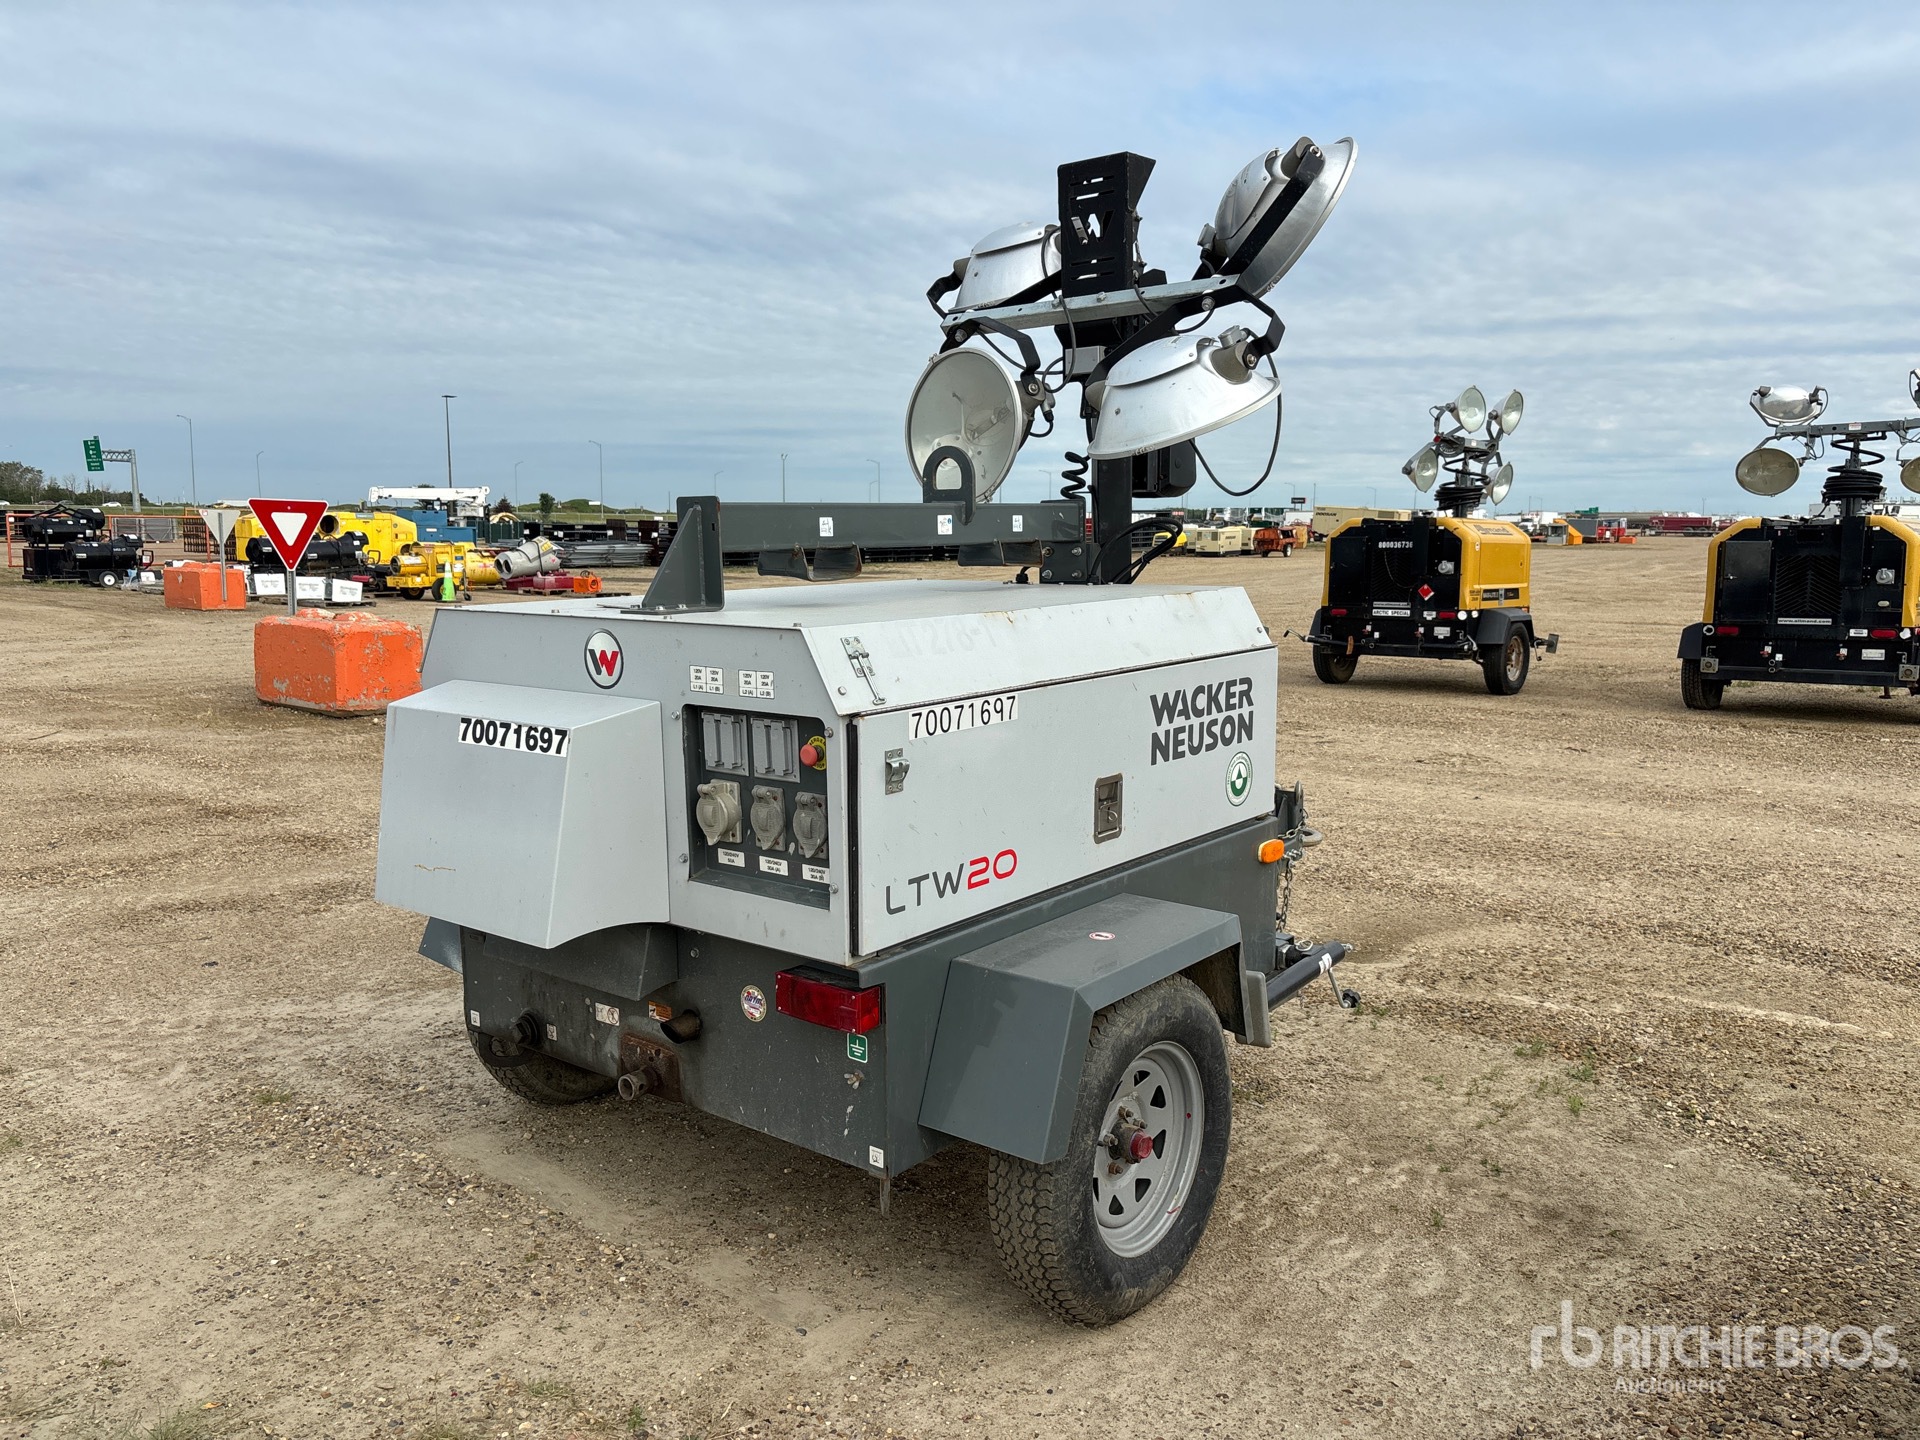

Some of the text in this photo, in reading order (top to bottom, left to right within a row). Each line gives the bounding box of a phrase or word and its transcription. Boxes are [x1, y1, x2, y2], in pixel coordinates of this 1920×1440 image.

[911, 695, 1016, 739] 70071697
[1150, 677, 1254, 727] WACKER
[460, 717, 568, 755] 70071697
[1151, 710, 1254, 766] NEUSON
[885, 848, 1018, 916] LTW20
